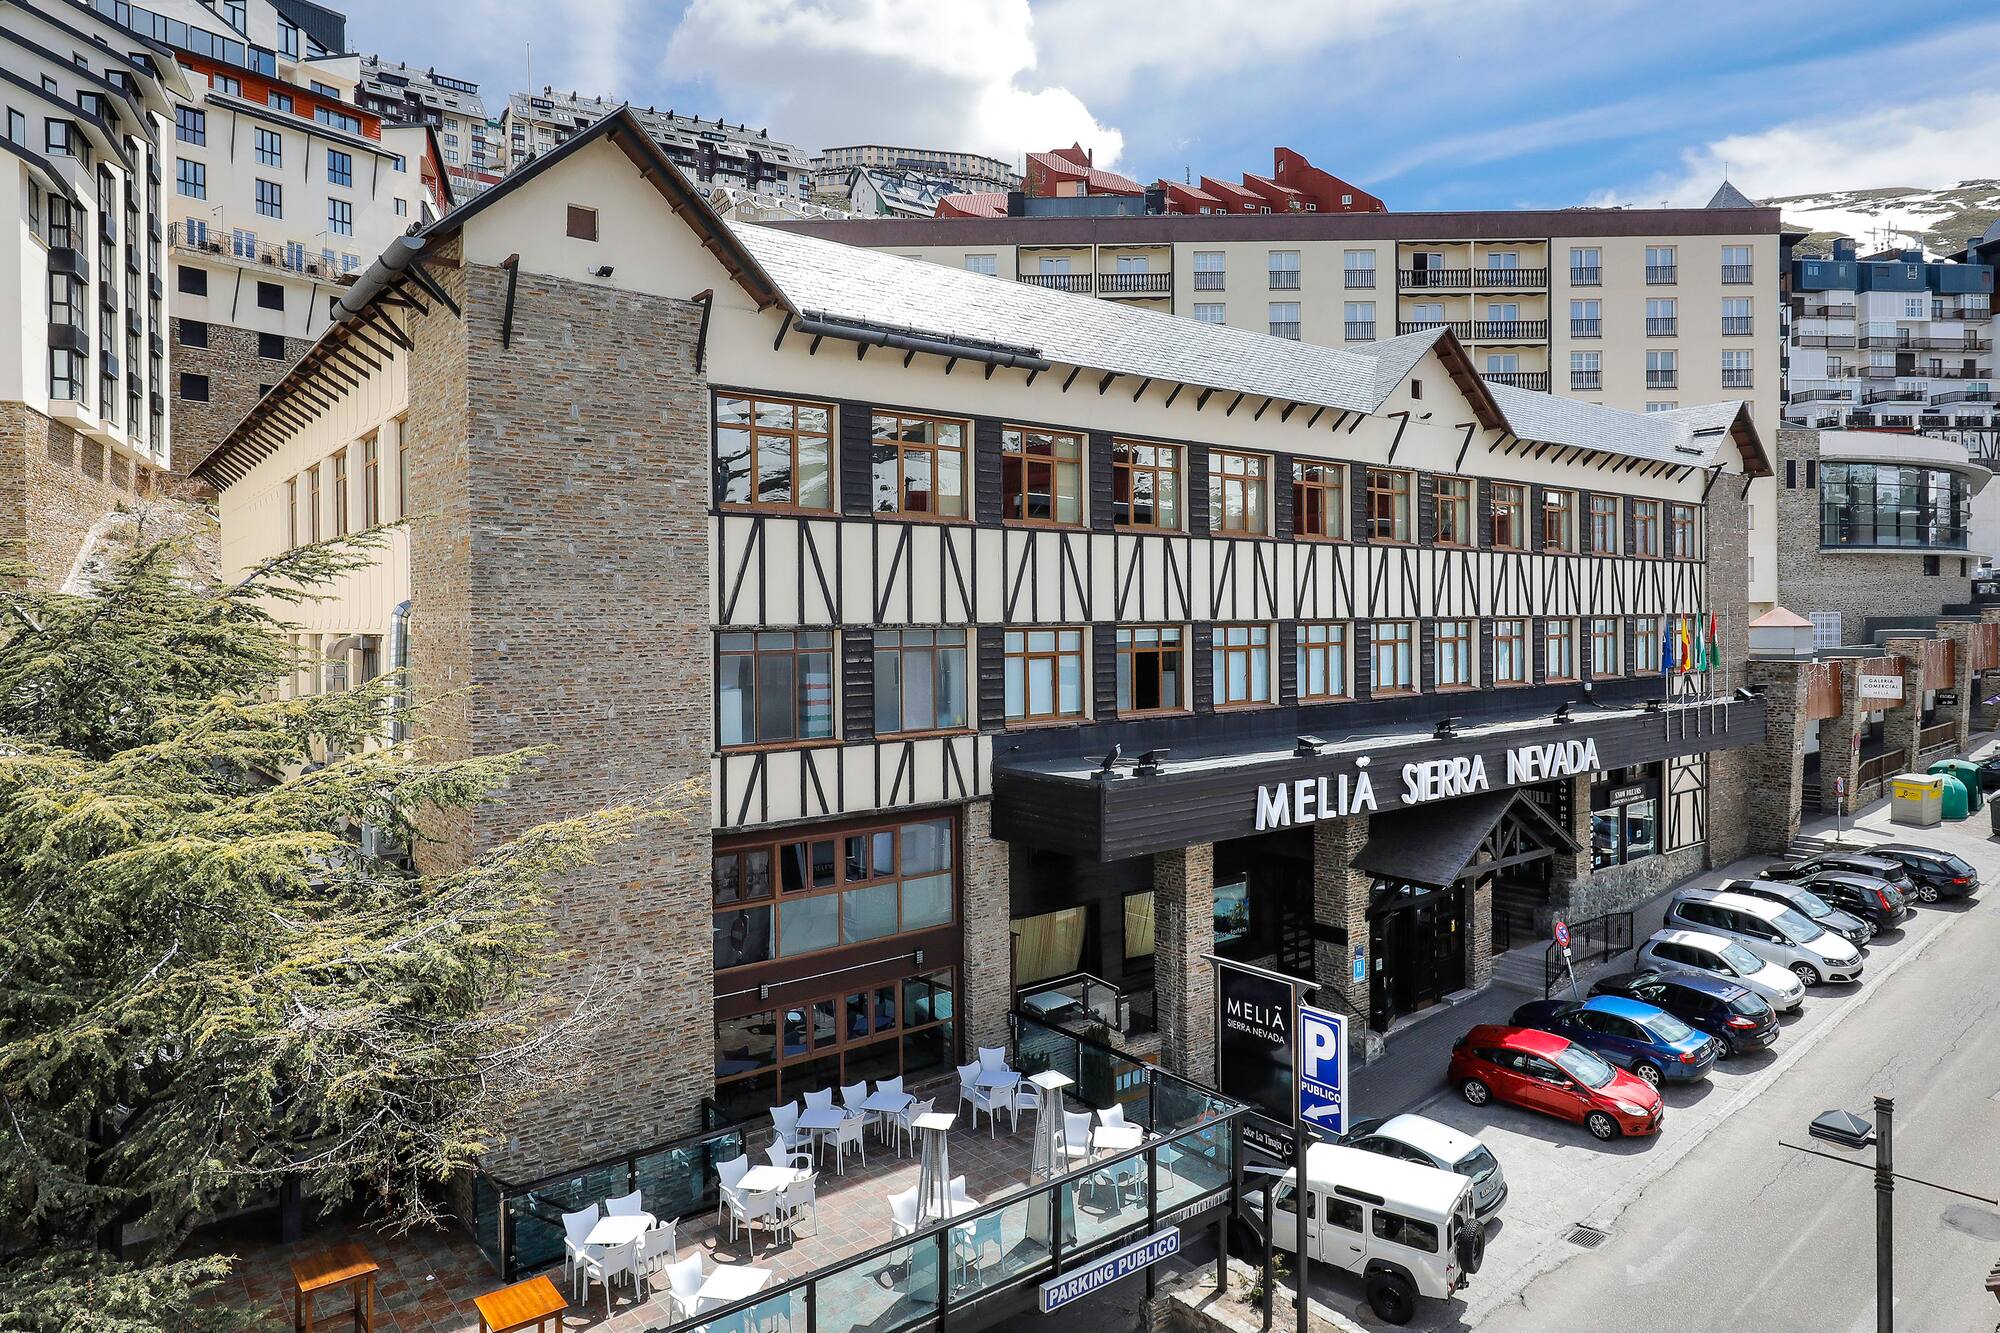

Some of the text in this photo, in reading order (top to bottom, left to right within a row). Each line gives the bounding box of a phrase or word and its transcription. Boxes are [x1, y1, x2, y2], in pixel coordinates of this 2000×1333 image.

[1401, 754, 1490, 805] SIERRA
[1507, 737, 1601, 785] NEVADA
[1227, 1018, 1286, 1044] SIERRA NEVADA
[1304, 1018, 1337, 1078] P
[1301, 1081, 1341, 1104] PUBLICO
[1049, 1232, 1177, 1307] PARKING PUBLICO
